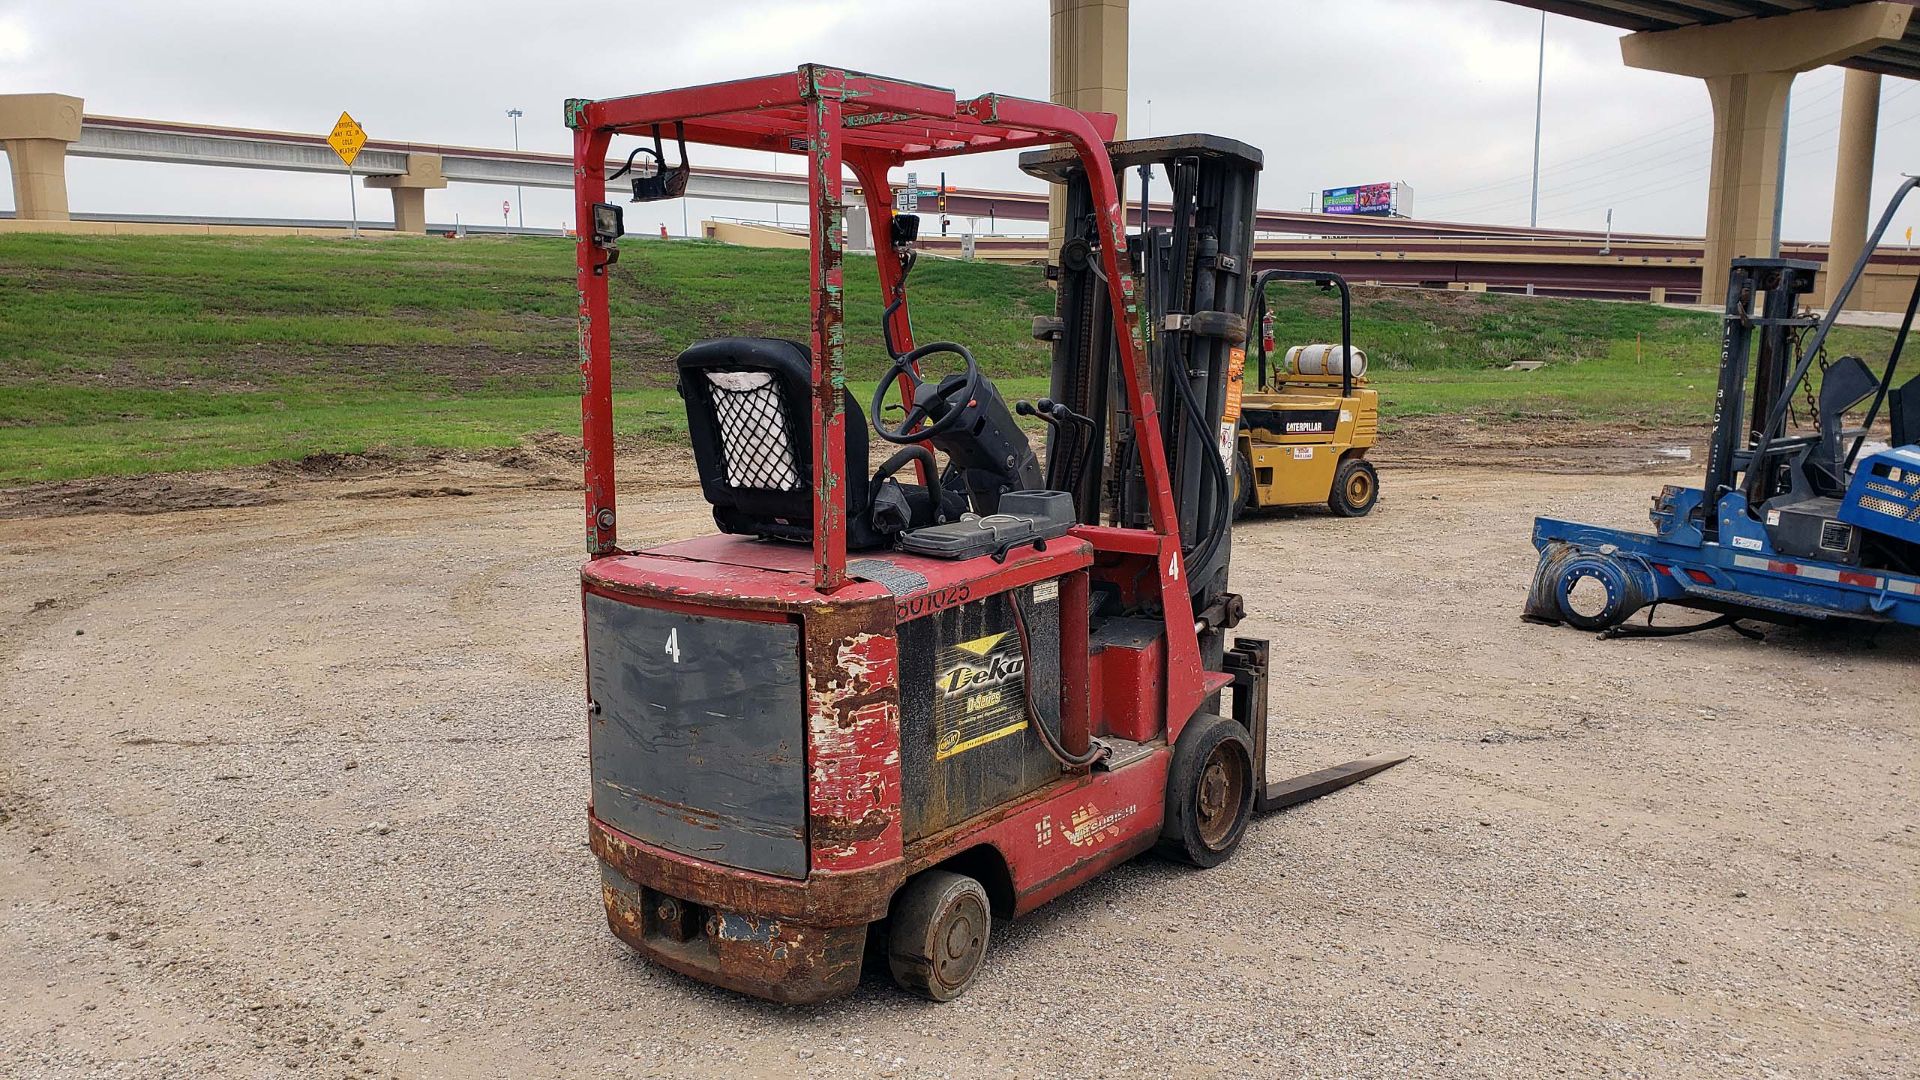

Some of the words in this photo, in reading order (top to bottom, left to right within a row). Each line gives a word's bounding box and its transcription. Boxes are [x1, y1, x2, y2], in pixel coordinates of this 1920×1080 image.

[1286, 422, 1323, 432] CATERPILLAR
[1168, 551, 1179, 581] 4
[664, 627, 681, 663] 4
[945, 652, 1024, 693] Deka
